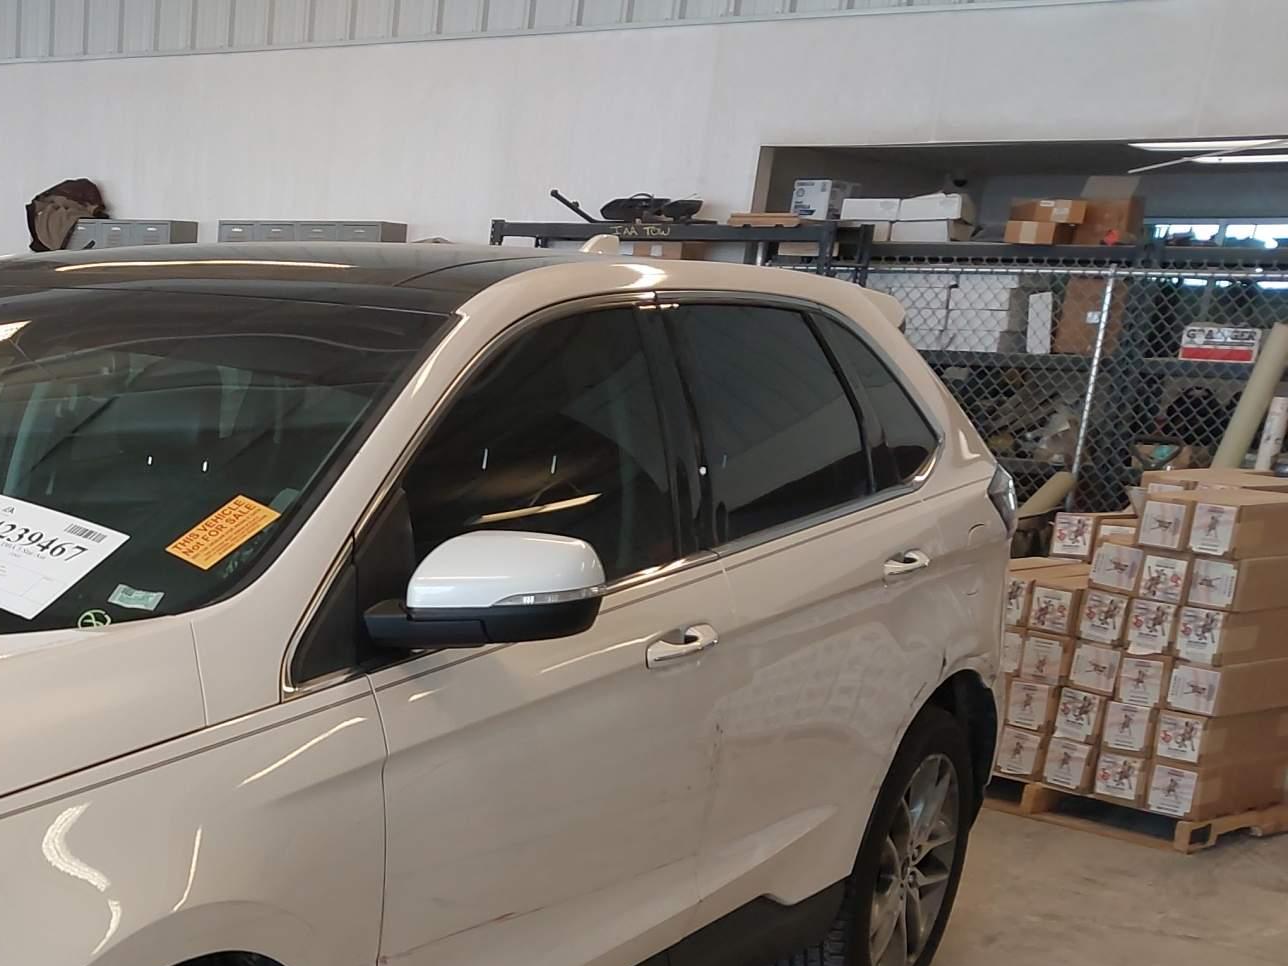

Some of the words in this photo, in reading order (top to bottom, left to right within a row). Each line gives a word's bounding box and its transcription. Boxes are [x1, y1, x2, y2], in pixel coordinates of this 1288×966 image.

[1186, 329, 1257, 341] GRAGER
[173, 532, 200, 551] THIS
[200, 499, 245, 532] VEHICLE
[182, 540, 204, 556] Not
[201, 522, 227, 543] FOR
[226, 502, 257, 525] SALE
